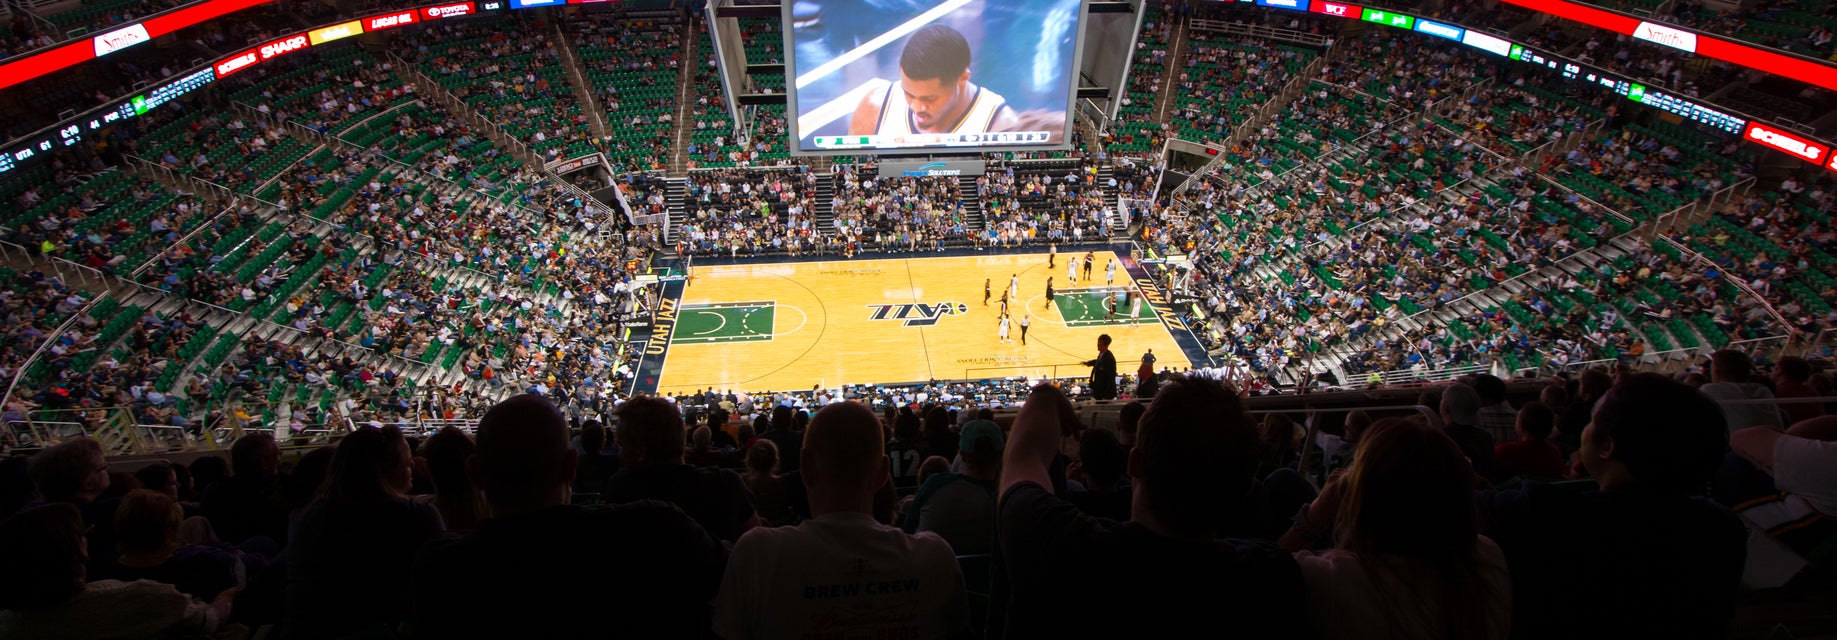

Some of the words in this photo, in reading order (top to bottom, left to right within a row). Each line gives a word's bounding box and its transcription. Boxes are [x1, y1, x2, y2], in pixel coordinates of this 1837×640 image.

[440, 4, 469, 14] TOYOTA
[261, 36, 305, 58] SHARP
[15, 148, 34, 161] UTA
[39, 140, 52, 151] 61
[1136, 278, 1167, 304] UTAH
[657, 297, 678, 322] JAZZ
[1151, 306, 1187, 330] JAZZ
[646, 324, 671, 355] UTAH
[890, 449, 920, 478] 12
[803, 583, 860, 599] BREW
[865, 578, 920, 595] CREW
